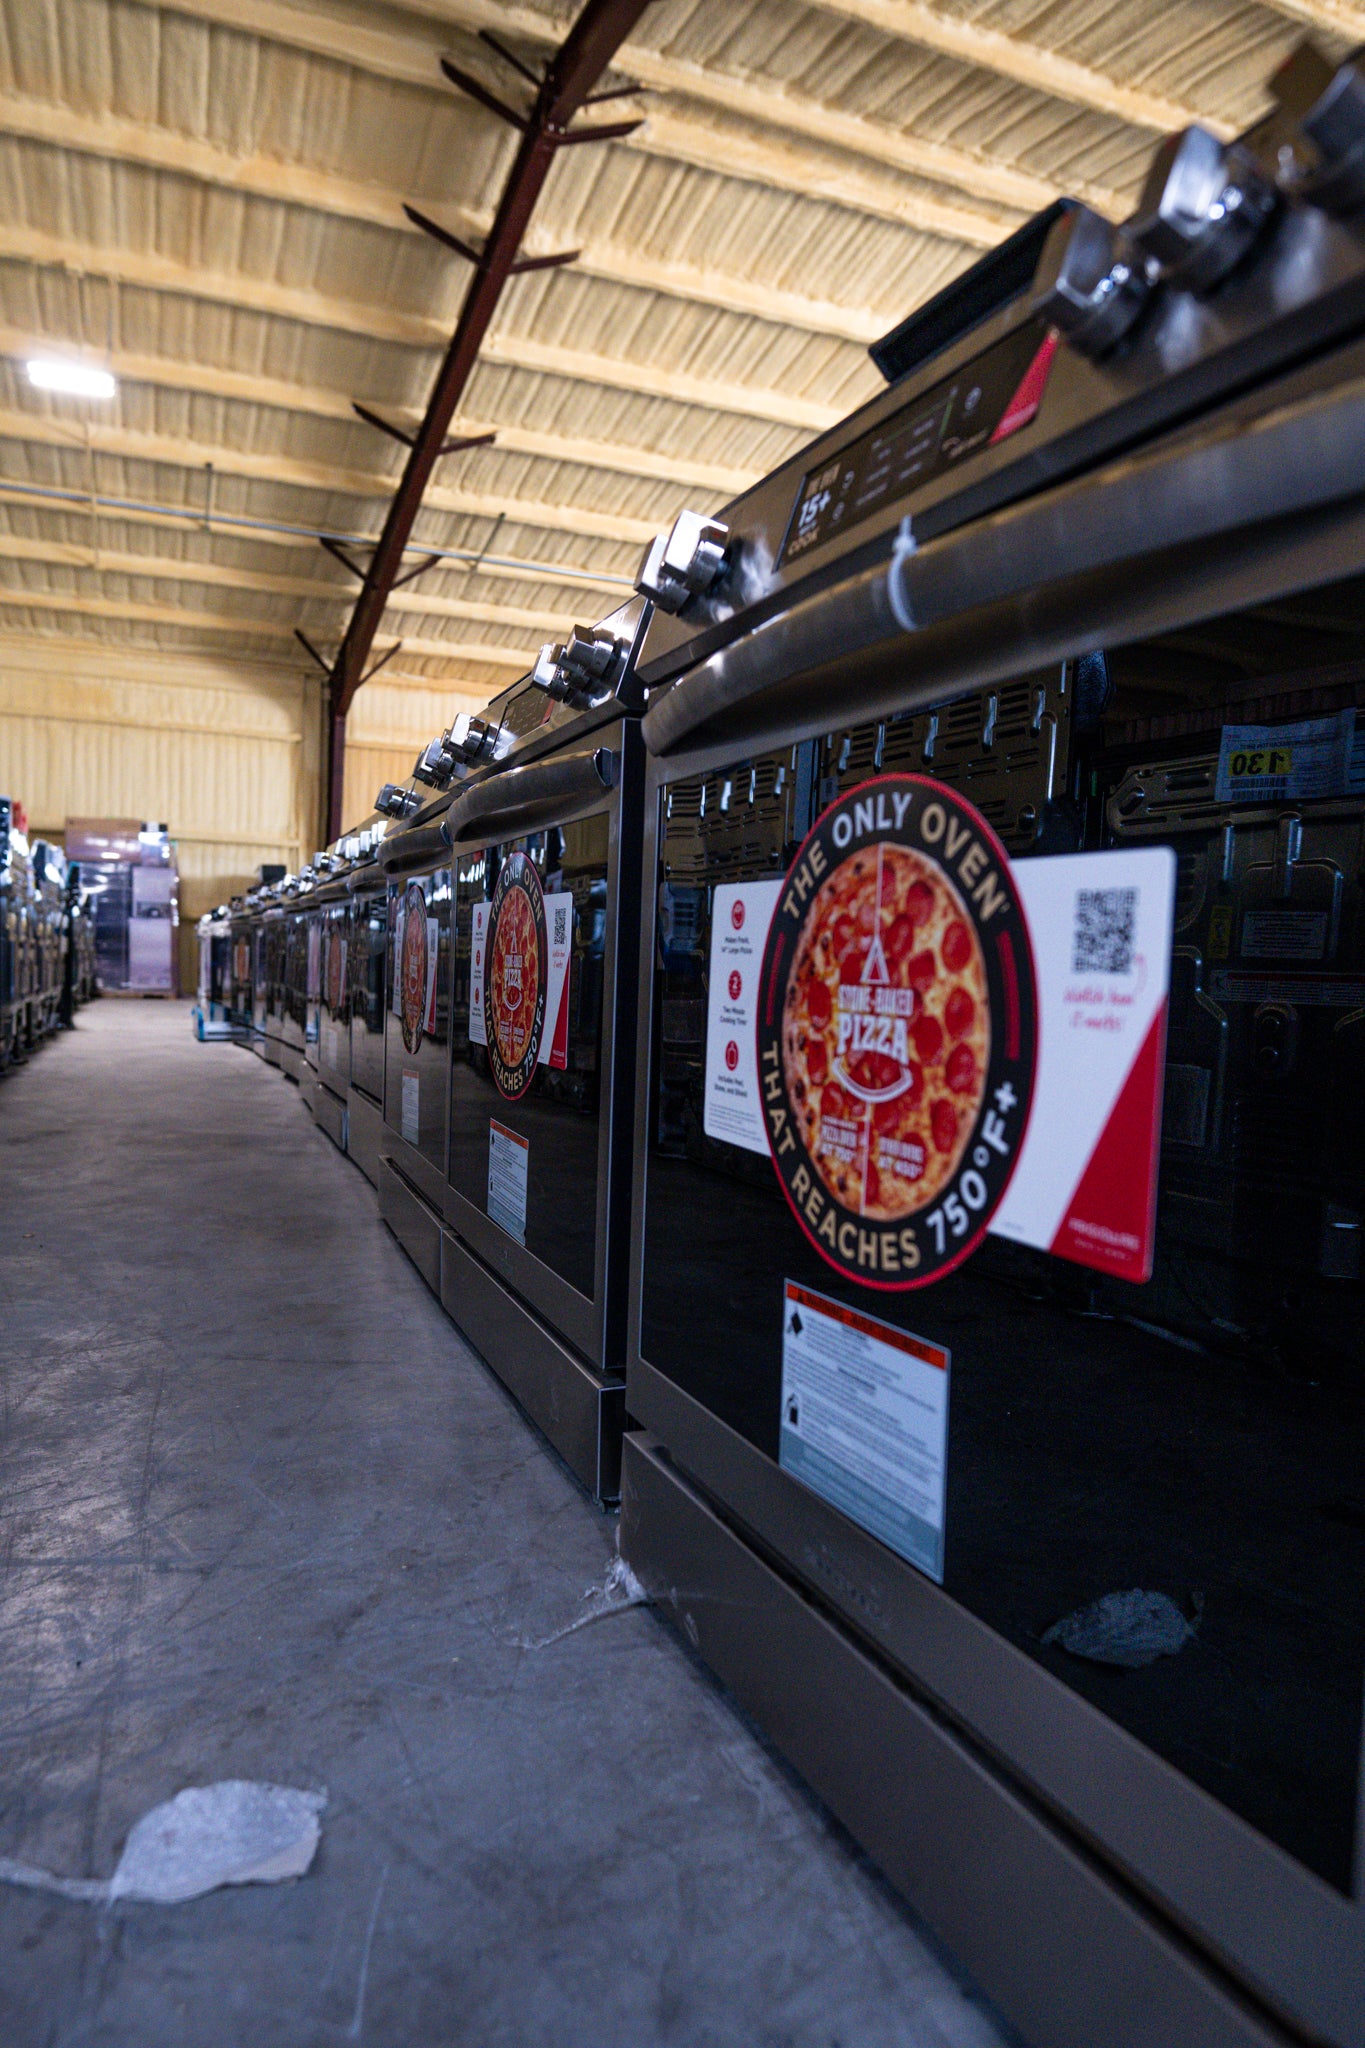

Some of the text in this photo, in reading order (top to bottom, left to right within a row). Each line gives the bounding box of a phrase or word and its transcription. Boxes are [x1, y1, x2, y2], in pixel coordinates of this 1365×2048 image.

[504, 862, 524, 887] ONLY
[782, 791, 1007, 922] THE ONLY OVEN
[836, 1011, 910, 1067] PIZZA
[492, 1047, 524, 1091] REACHES
[762, 1040, 797, 1155] THAT
[790, 1163, 922, 1272] REACHES
